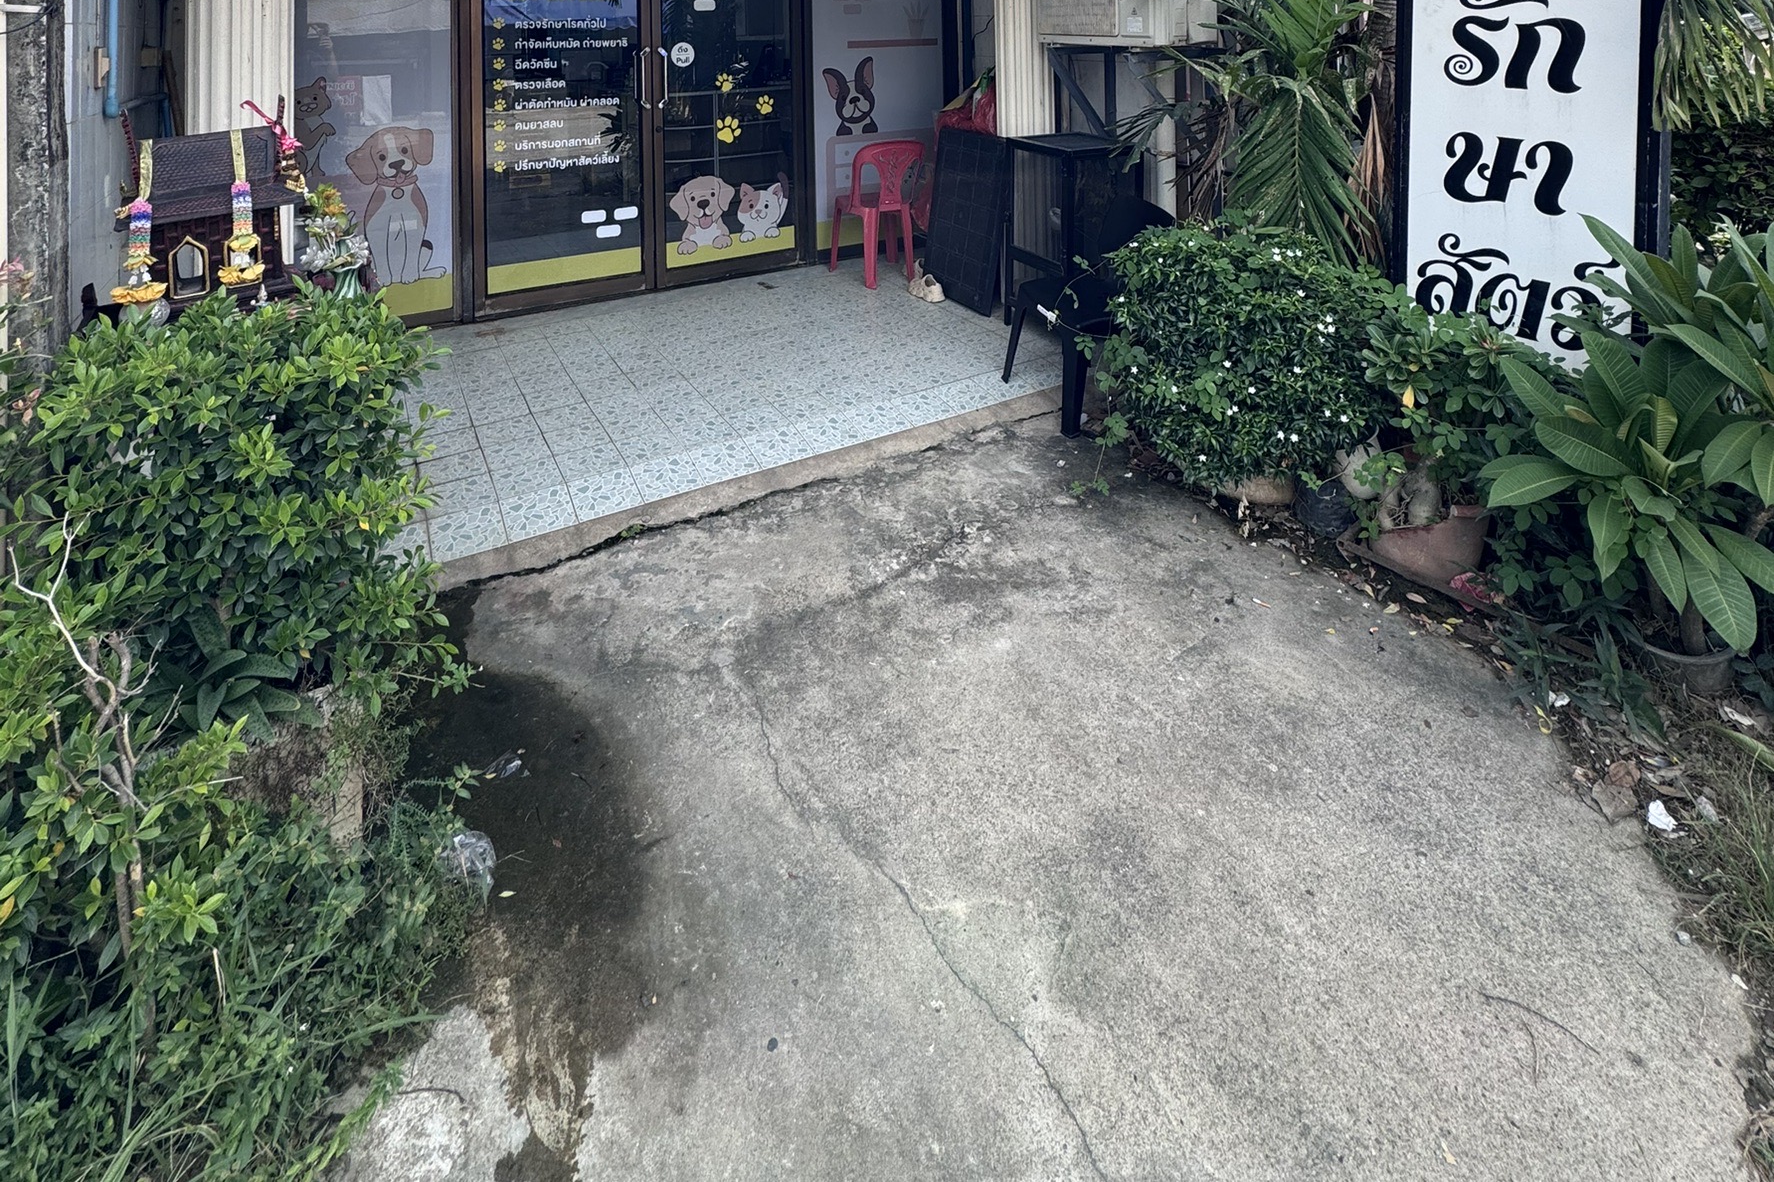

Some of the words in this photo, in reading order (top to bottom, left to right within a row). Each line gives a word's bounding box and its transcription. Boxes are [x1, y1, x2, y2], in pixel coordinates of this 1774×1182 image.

[514, 15, 607, 29] ตรวจรักษาโรคทั่วไป
[514, 37, 580, 50] กำจัดเห็บหมัด
[582, 37, 628, 48] ถ่ายพยาธิ
[514, 58, 557, 70] ฉีดวัคซีน
[676, 56, 690, 64] Pull
[514, 78, 566, 90] ตรวจเลือด
[514, 97, 577, 110] ผ่าตัดทำหมัน
[580, 95, 620, 107] ผ่าคลอด
[514, 119, 564, 131] ดมยาสลบ
[514, 133, 601, 150] บริการนอกสถานที่
[514, 151, 620, 171] ปรึกษาปัญหาสัตว์เลี้ยง
[1443, 131, 1574, 216] ษา
